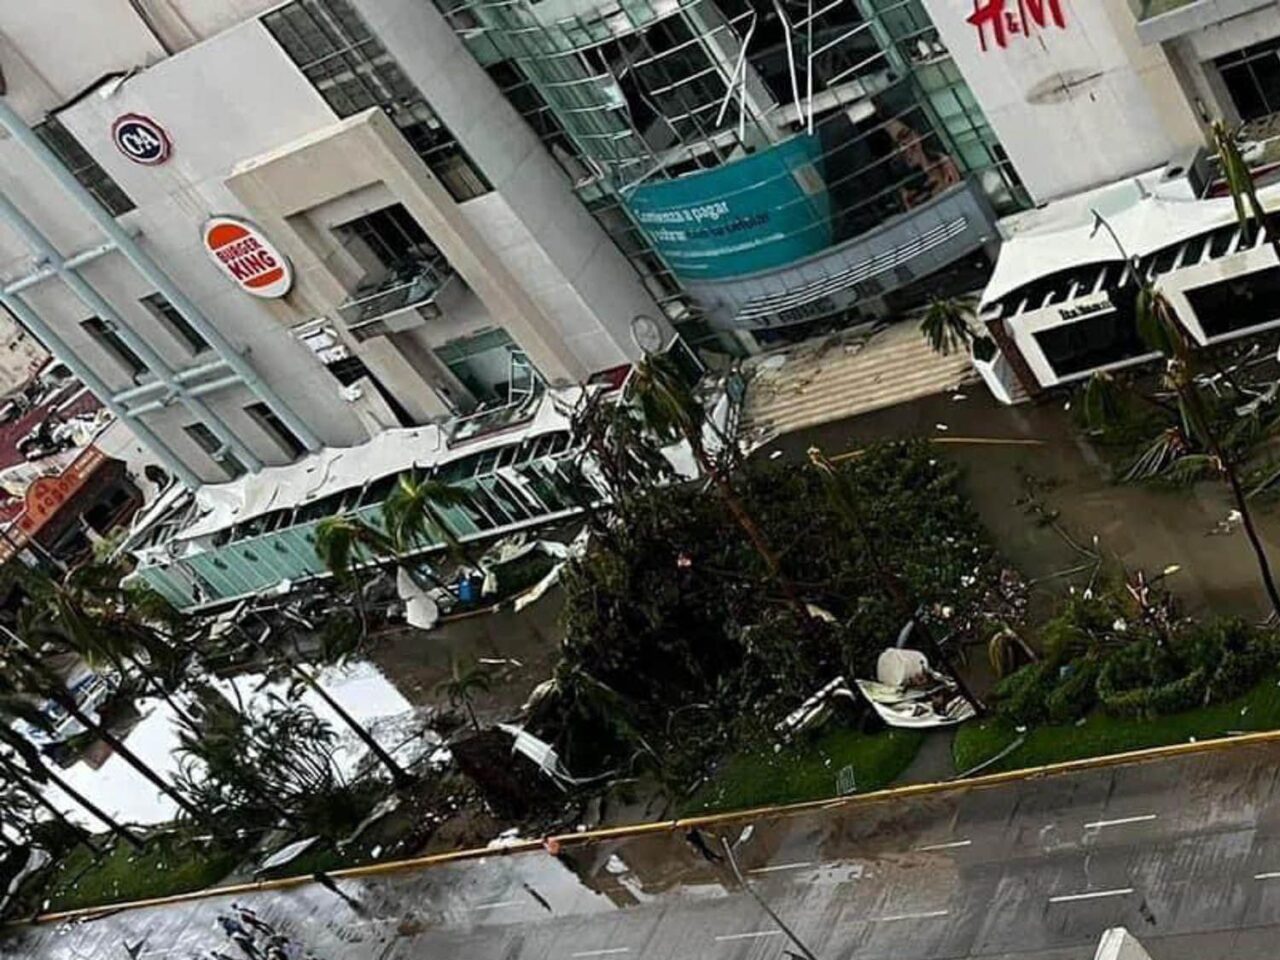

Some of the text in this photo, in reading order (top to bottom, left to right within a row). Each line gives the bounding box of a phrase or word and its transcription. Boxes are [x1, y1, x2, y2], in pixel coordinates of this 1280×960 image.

[965, 0, 1066, 51] H&M
[692, 201, 730, 222] pagar
[216, 237, 263, 264] BURGER
[227, 250, 277, 280] KING
